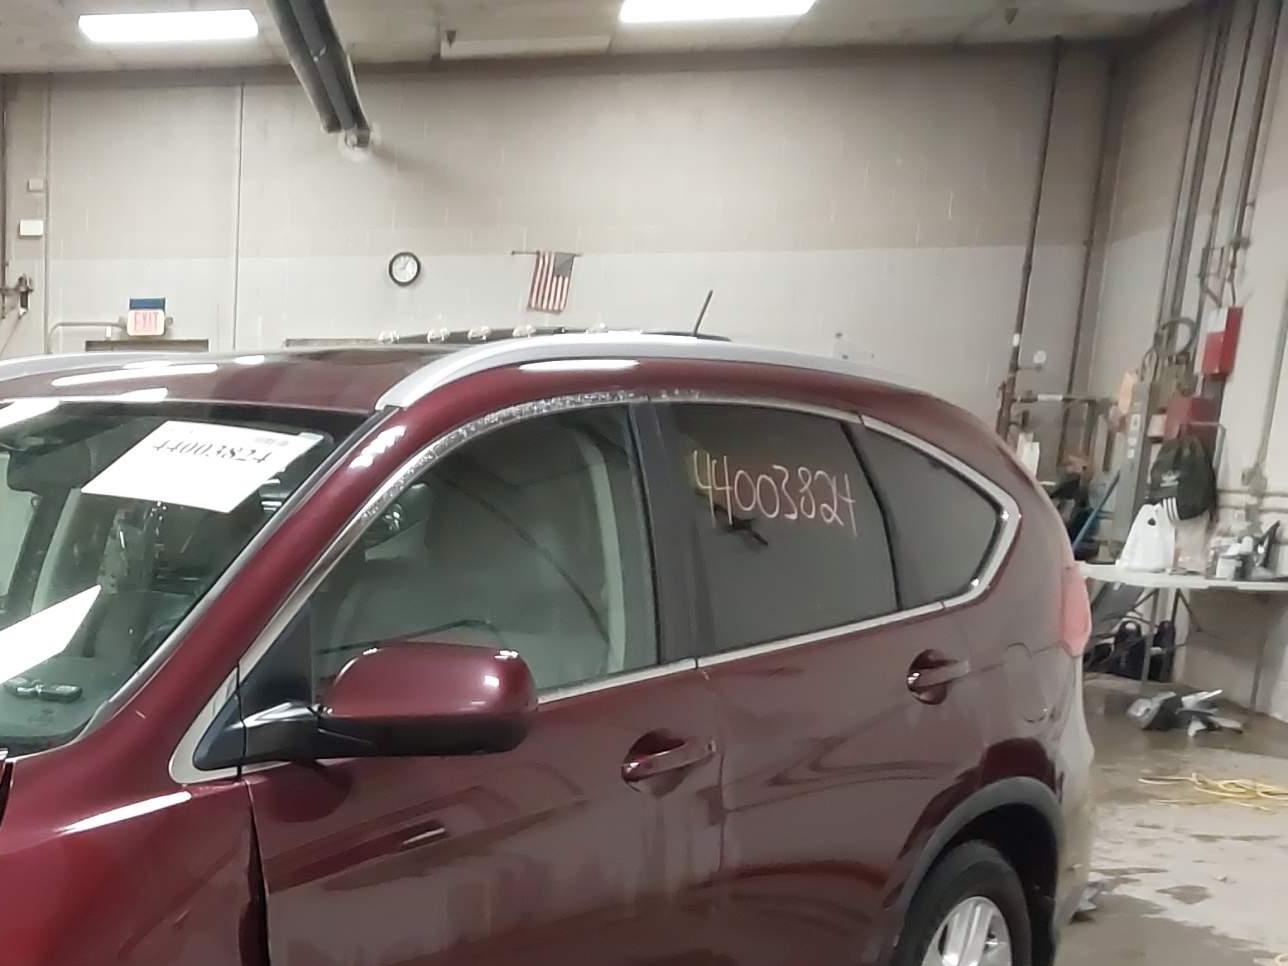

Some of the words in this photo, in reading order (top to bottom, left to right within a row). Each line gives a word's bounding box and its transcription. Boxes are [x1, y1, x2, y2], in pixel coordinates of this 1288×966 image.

[133, 311, 160, 331] EXIT
[152, 439, 273, 464] 44003824
[694, 450, 858, 537] 44003824
